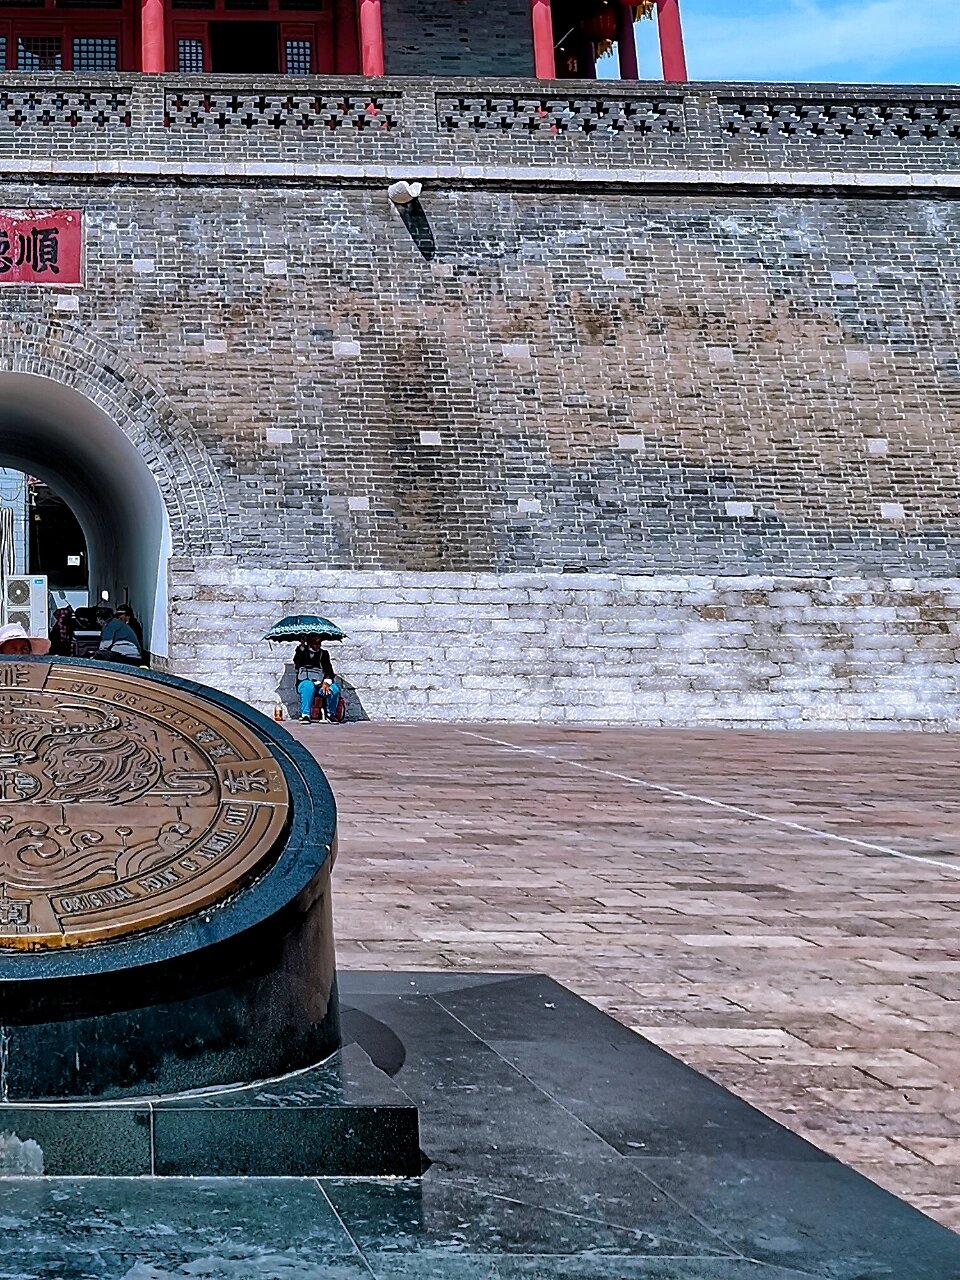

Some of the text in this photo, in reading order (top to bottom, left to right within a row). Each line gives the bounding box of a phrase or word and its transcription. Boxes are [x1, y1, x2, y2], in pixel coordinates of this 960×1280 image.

[222, 767, 270, 795] 东
[59, 888, 135, 912] ORIGINAL
[139, 870, 184, 892] POINT
[178, 856, 200, 871] OF
